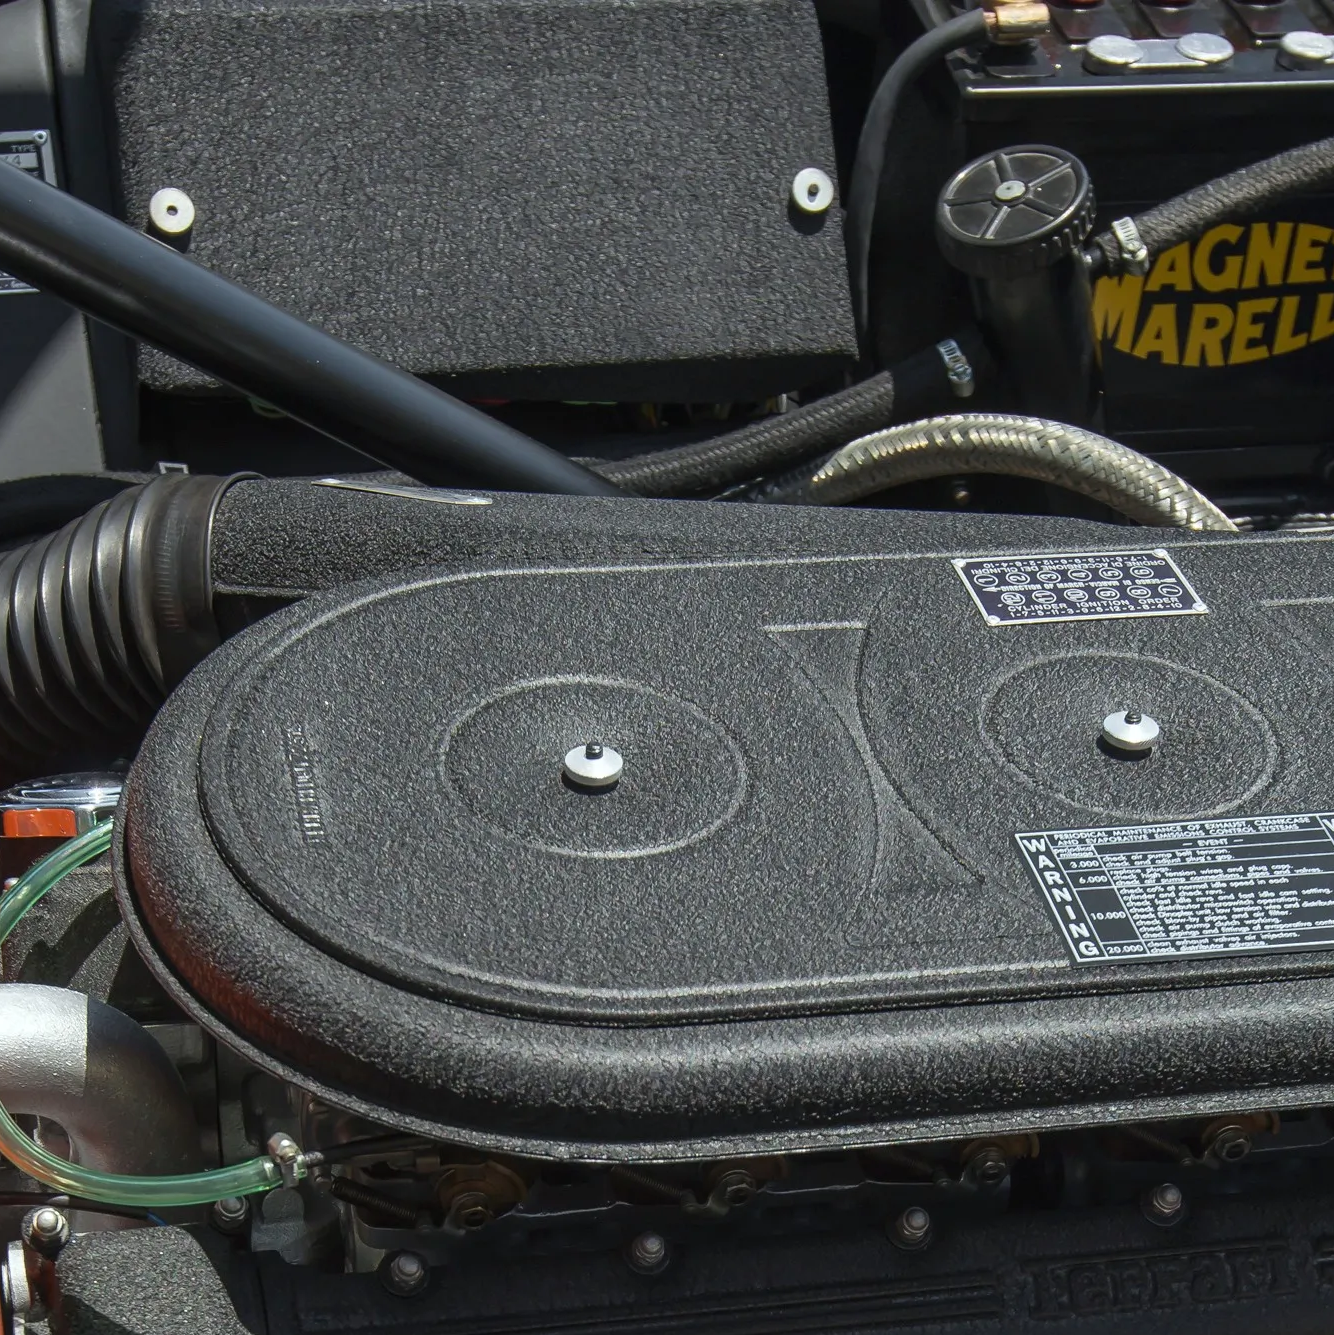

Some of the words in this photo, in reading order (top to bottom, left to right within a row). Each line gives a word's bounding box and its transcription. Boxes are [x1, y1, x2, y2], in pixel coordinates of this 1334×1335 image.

[10, 144, 36, 152] TYPE
[1007, 603, 1068, 612] CYLINDER
[1075, 599, 1130, 608] IGNITION
[1136, 596, 1179, 604] ORDER
[1197, 838, 1229, 846] EVENT
[1022, 837, 1101, 957] WARNING
